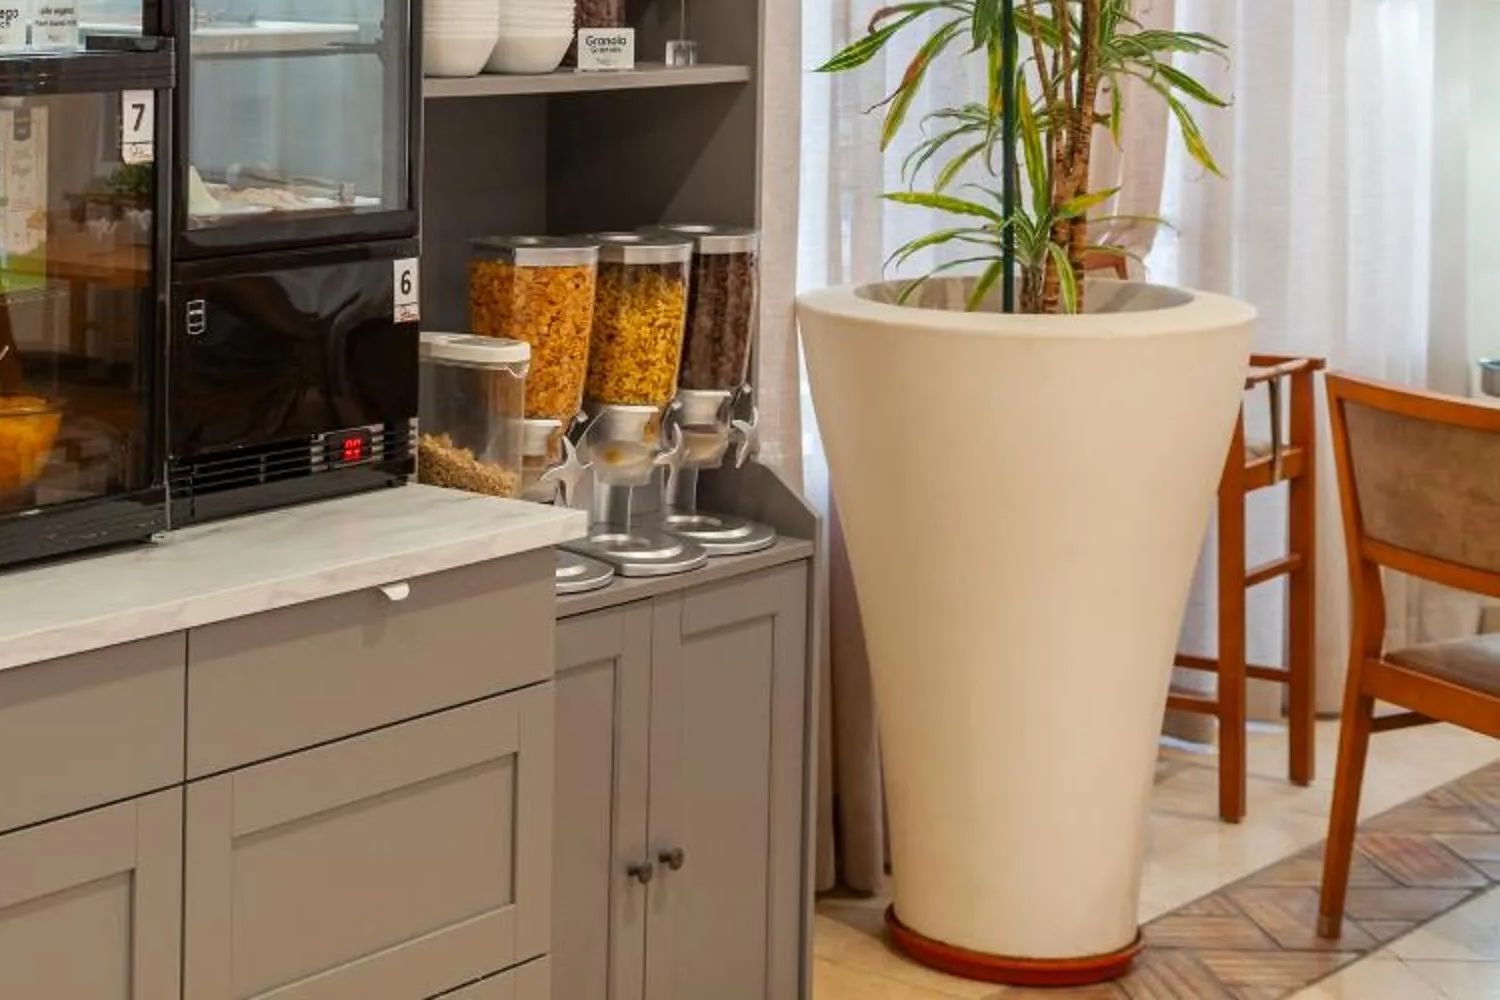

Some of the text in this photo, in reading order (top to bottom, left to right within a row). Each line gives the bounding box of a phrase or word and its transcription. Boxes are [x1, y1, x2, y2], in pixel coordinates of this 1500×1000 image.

[585, 34, 627, 47] Granola
[131, 103, 146, 132] 7
[401, 269, 412, 296] 6
